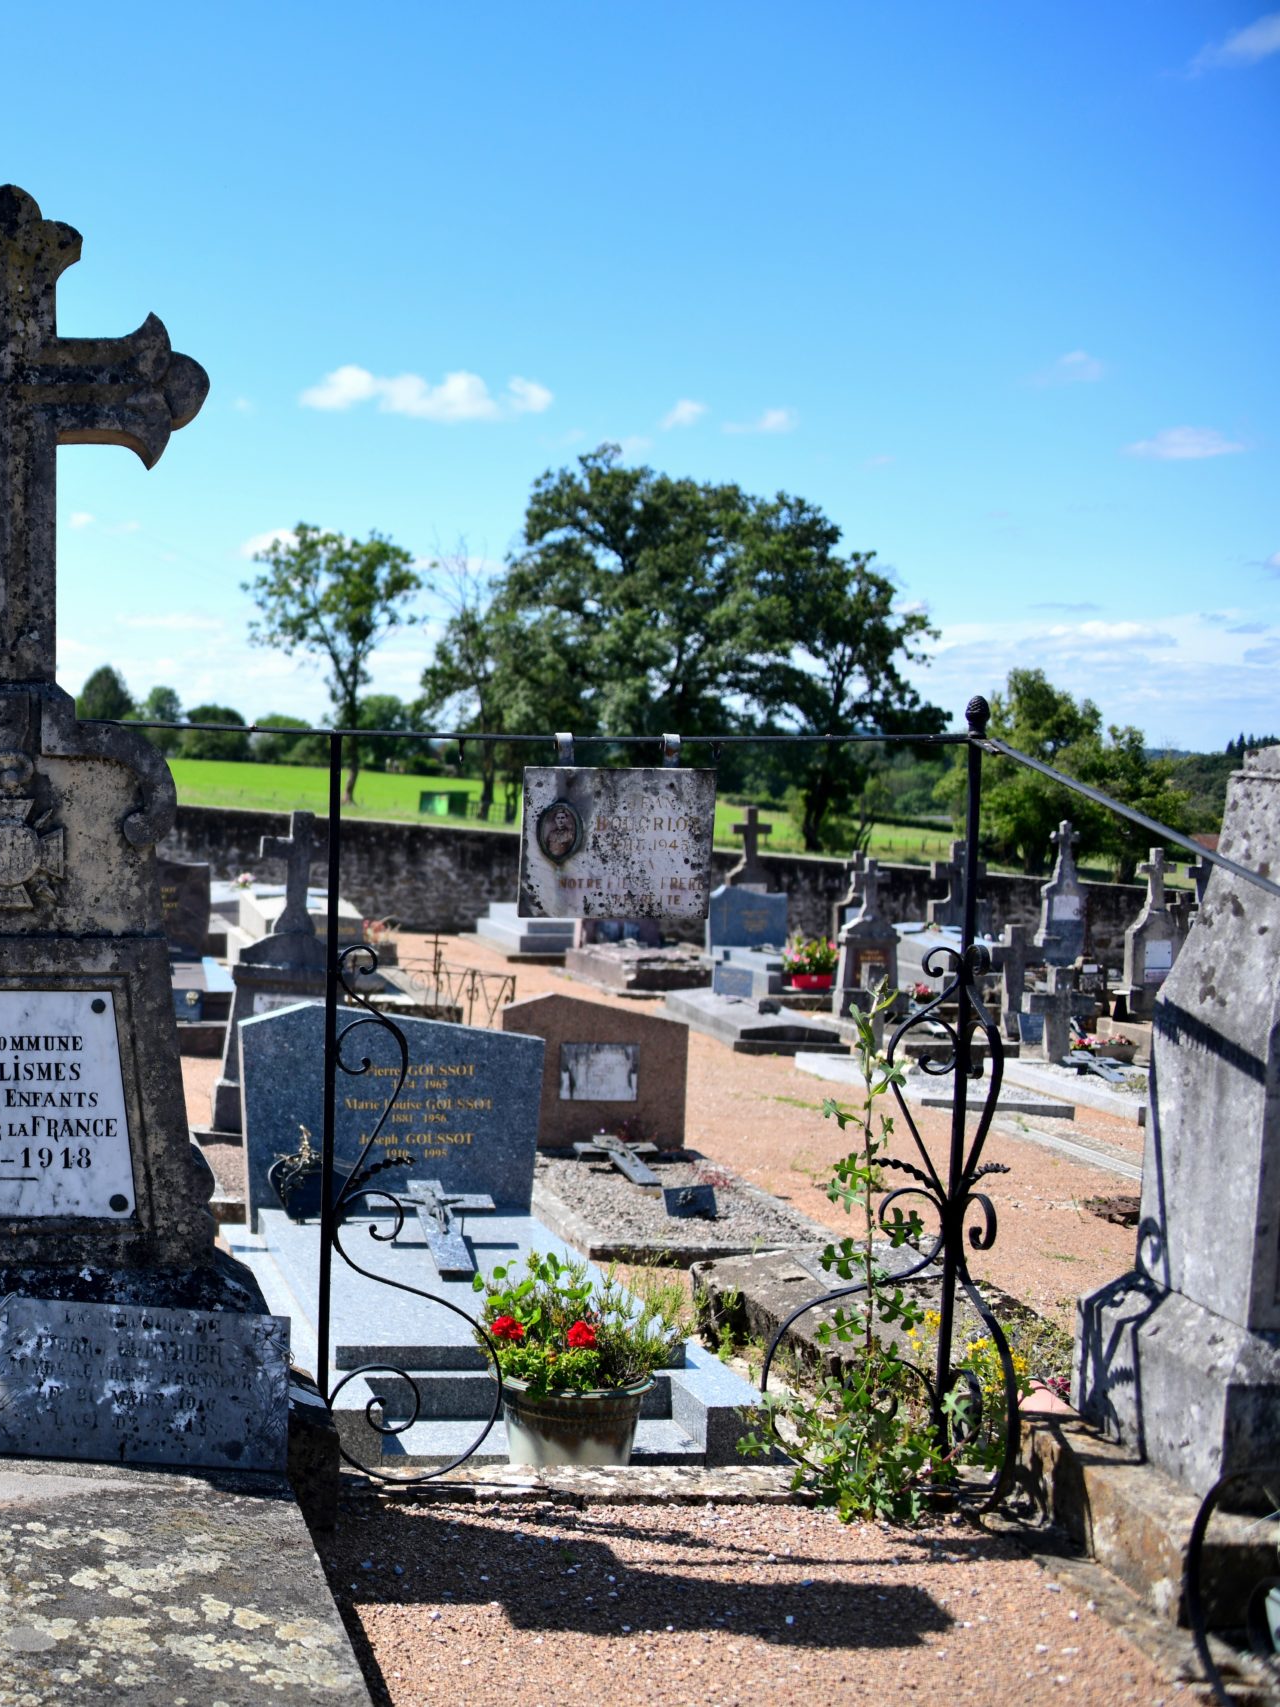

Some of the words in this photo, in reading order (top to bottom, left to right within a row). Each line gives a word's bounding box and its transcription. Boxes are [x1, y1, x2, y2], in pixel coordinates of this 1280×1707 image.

[407, 1064, 475, 1077] GOUSSOT
[424, 1079, 448, 1089] 1965
[425, 1098, 494, 1110] GOUSSOT
[406, 1132, 475, 1145] GOUSSOT
